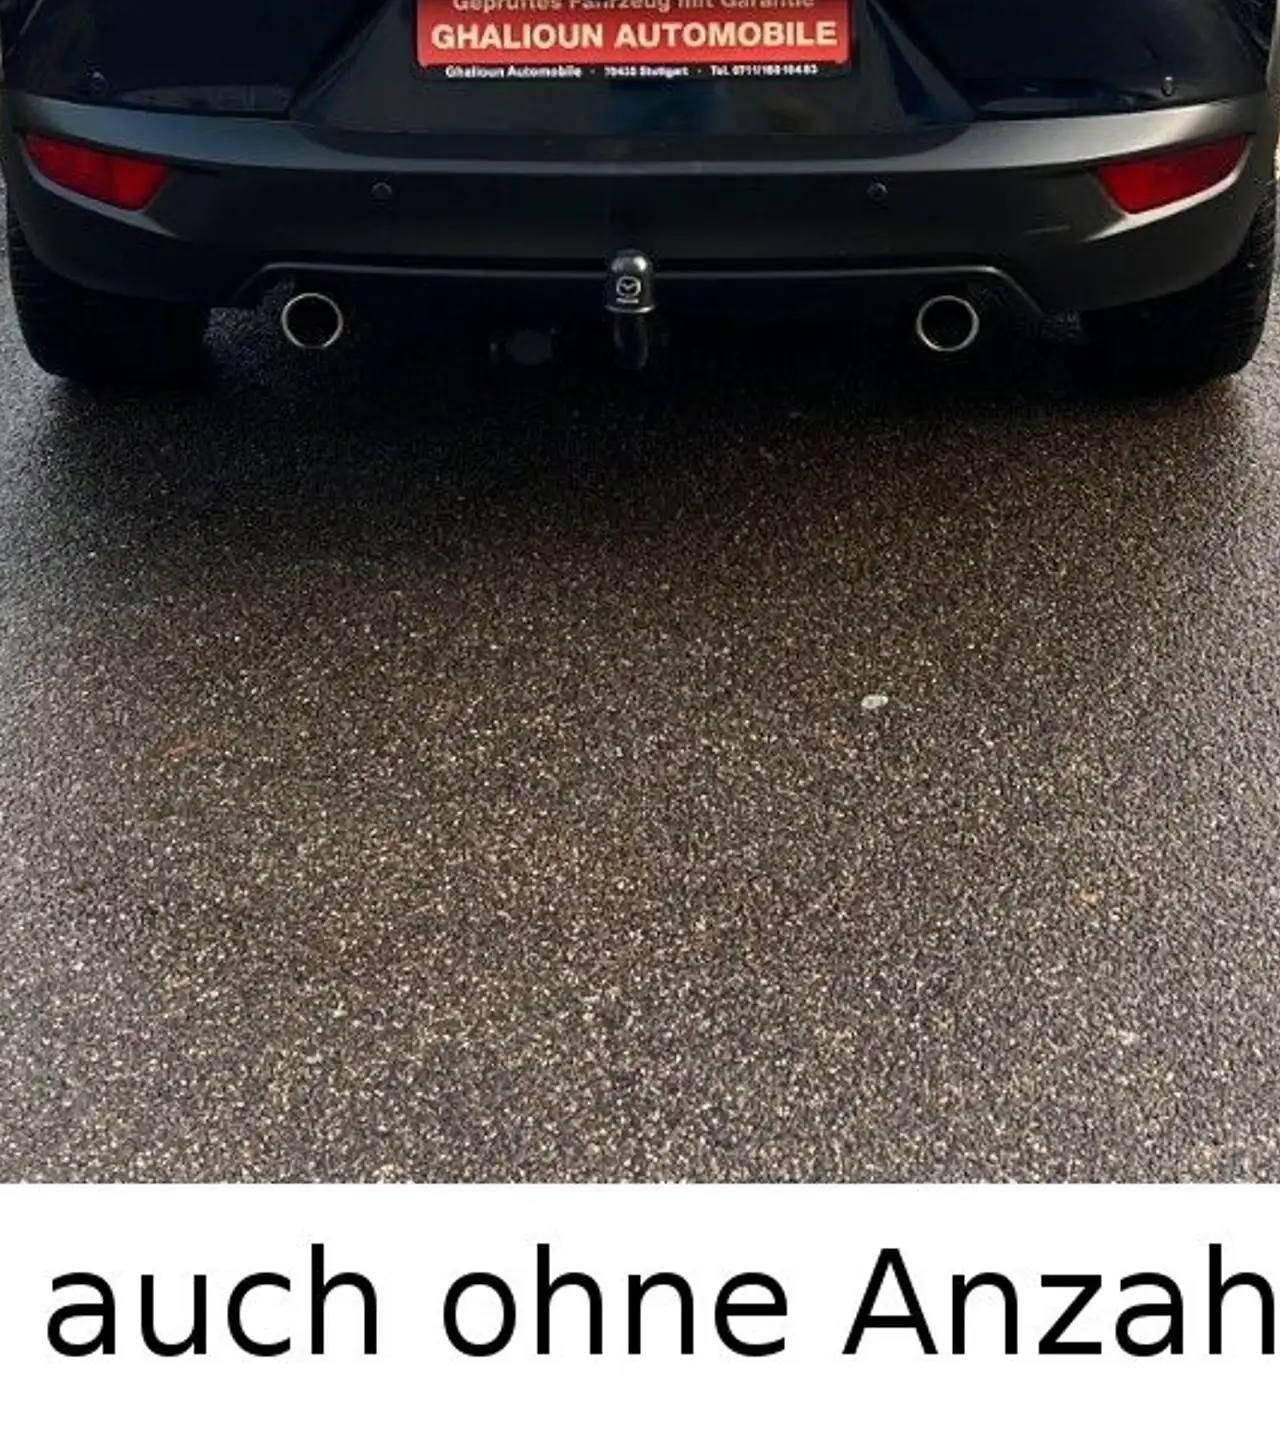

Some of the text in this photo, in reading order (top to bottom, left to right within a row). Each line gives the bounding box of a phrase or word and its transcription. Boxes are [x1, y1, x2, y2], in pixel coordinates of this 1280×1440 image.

[431, 20, 838, 50] GHALIOUN AUTOMOBILE
[445, 64, 505, 78] Ghalioun
[507, 64, 582, 78] Automobile
